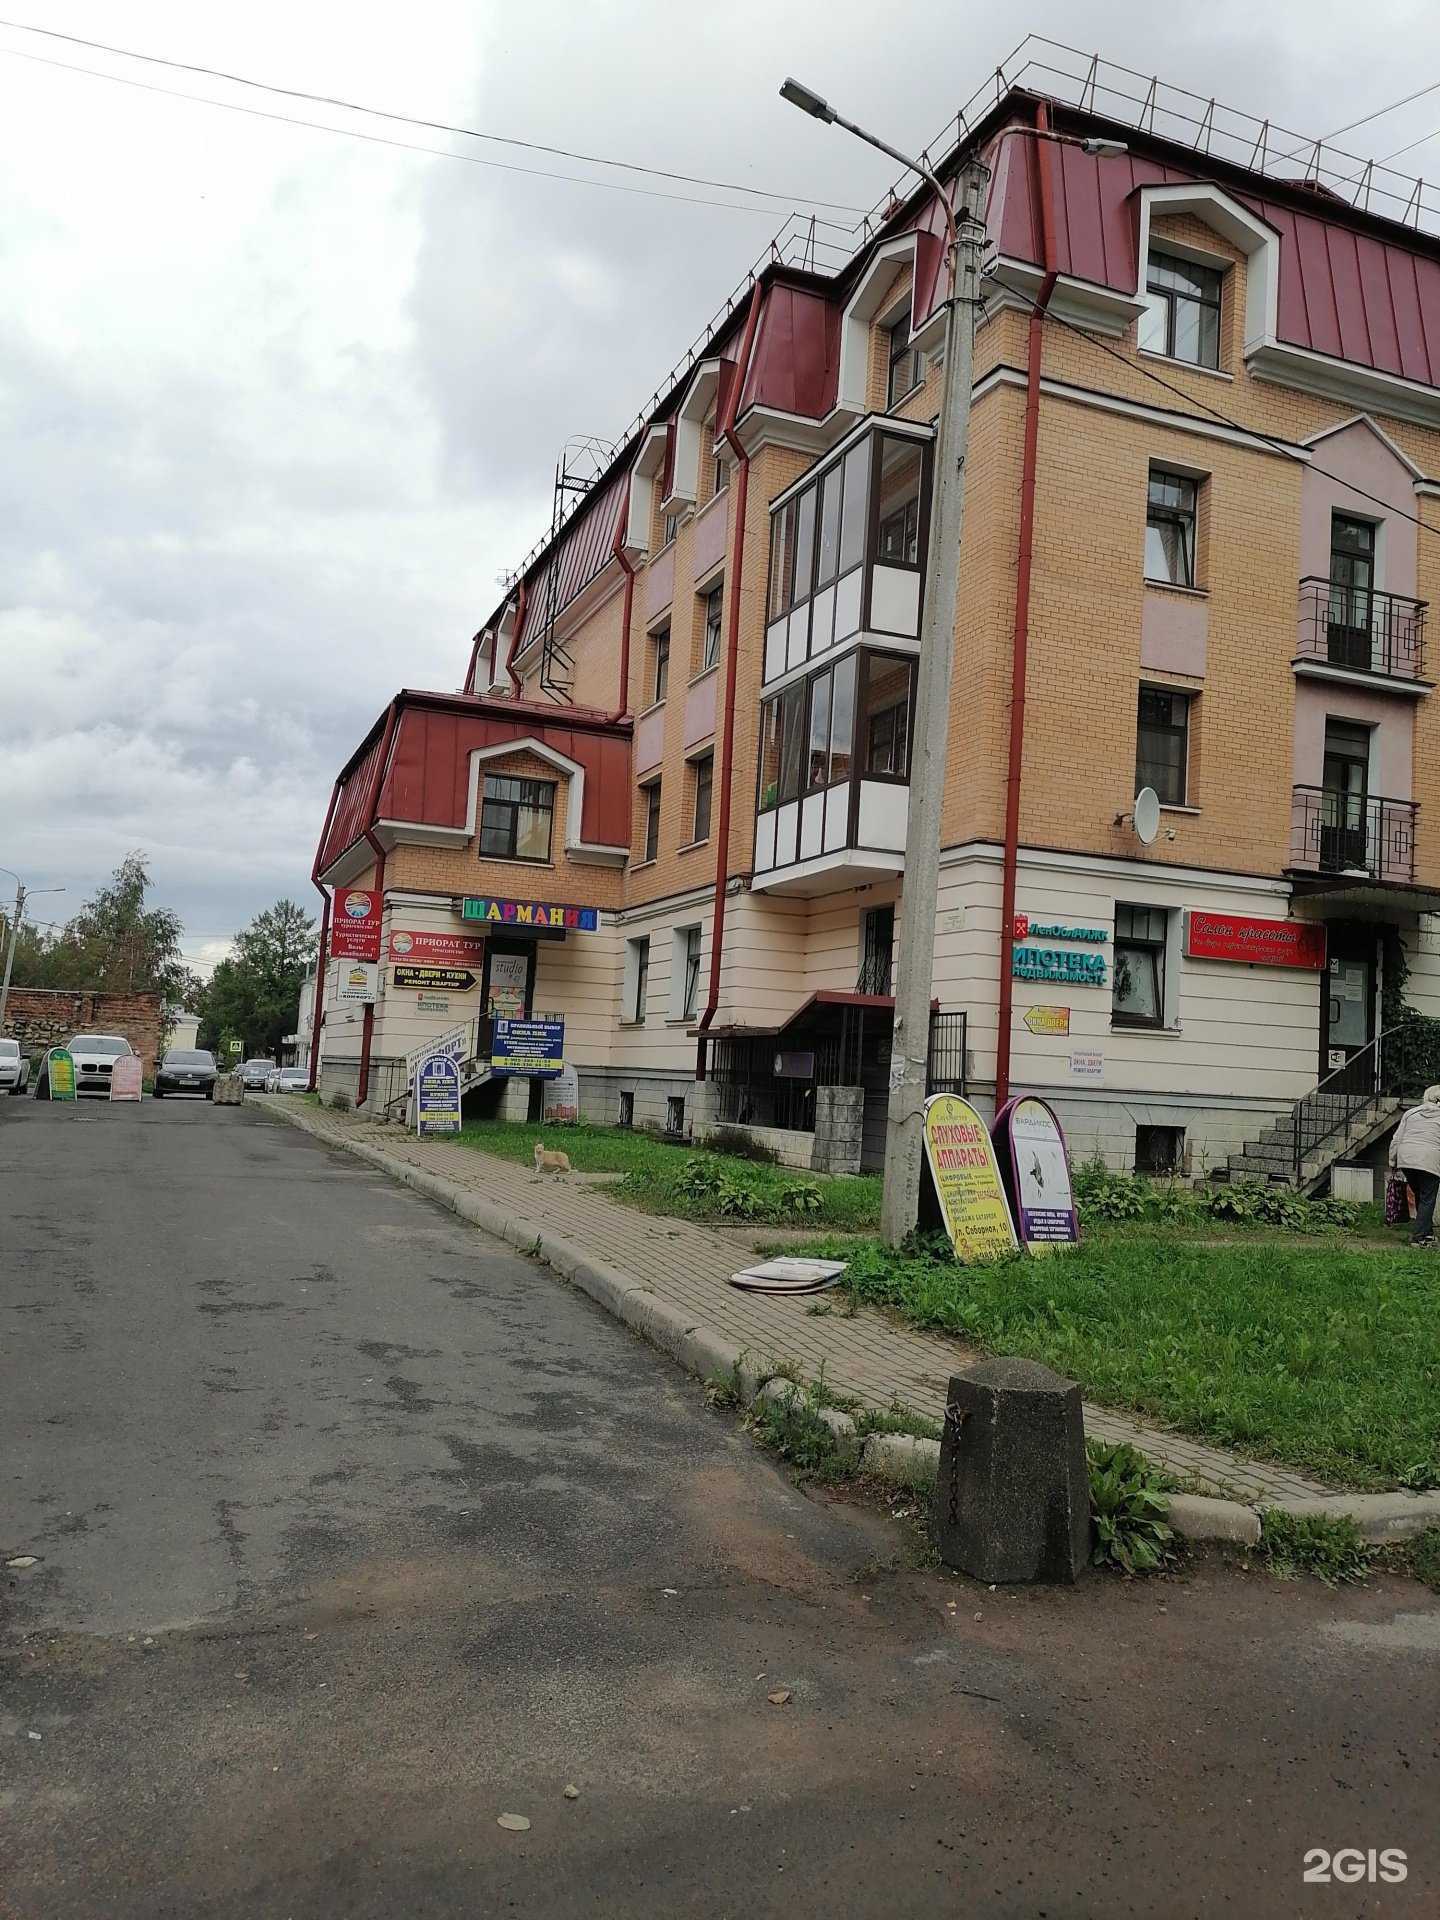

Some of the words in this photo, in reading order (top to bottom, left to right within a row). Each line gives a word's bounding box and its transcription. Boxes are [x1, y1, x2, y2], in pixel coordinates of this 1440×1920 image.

[464, 900, 594, 929] ШАРМАНИЯ
[334, 917, 365, 926] ПРИОРАТ
[368, 919, 380, 927] ТУР
[335, 931, 378, 940] Туристические
[1193, 915, 1233, 937] Салон
[1238, 926, 1297, 944] красоты
[415, 937, 460, 949] ПРИОРАТ
[463, 941, 481, 950] ТУР
[1013, 946, 1107, 971] ИПОТЕКА
[396, 968, 414, 976] ОКНА
[418, 970, 440, 978] ДВЕРИ
[446, 972, 467, 980] КУХНИ
[496, 960, 523, 974] studio
[931, 1124, 982, 1144] СЛУХОВЫЕ
[936, 1147, 989, 1169] АППАРАТЫ
[1000, 1222, 1007, 1232] 10
